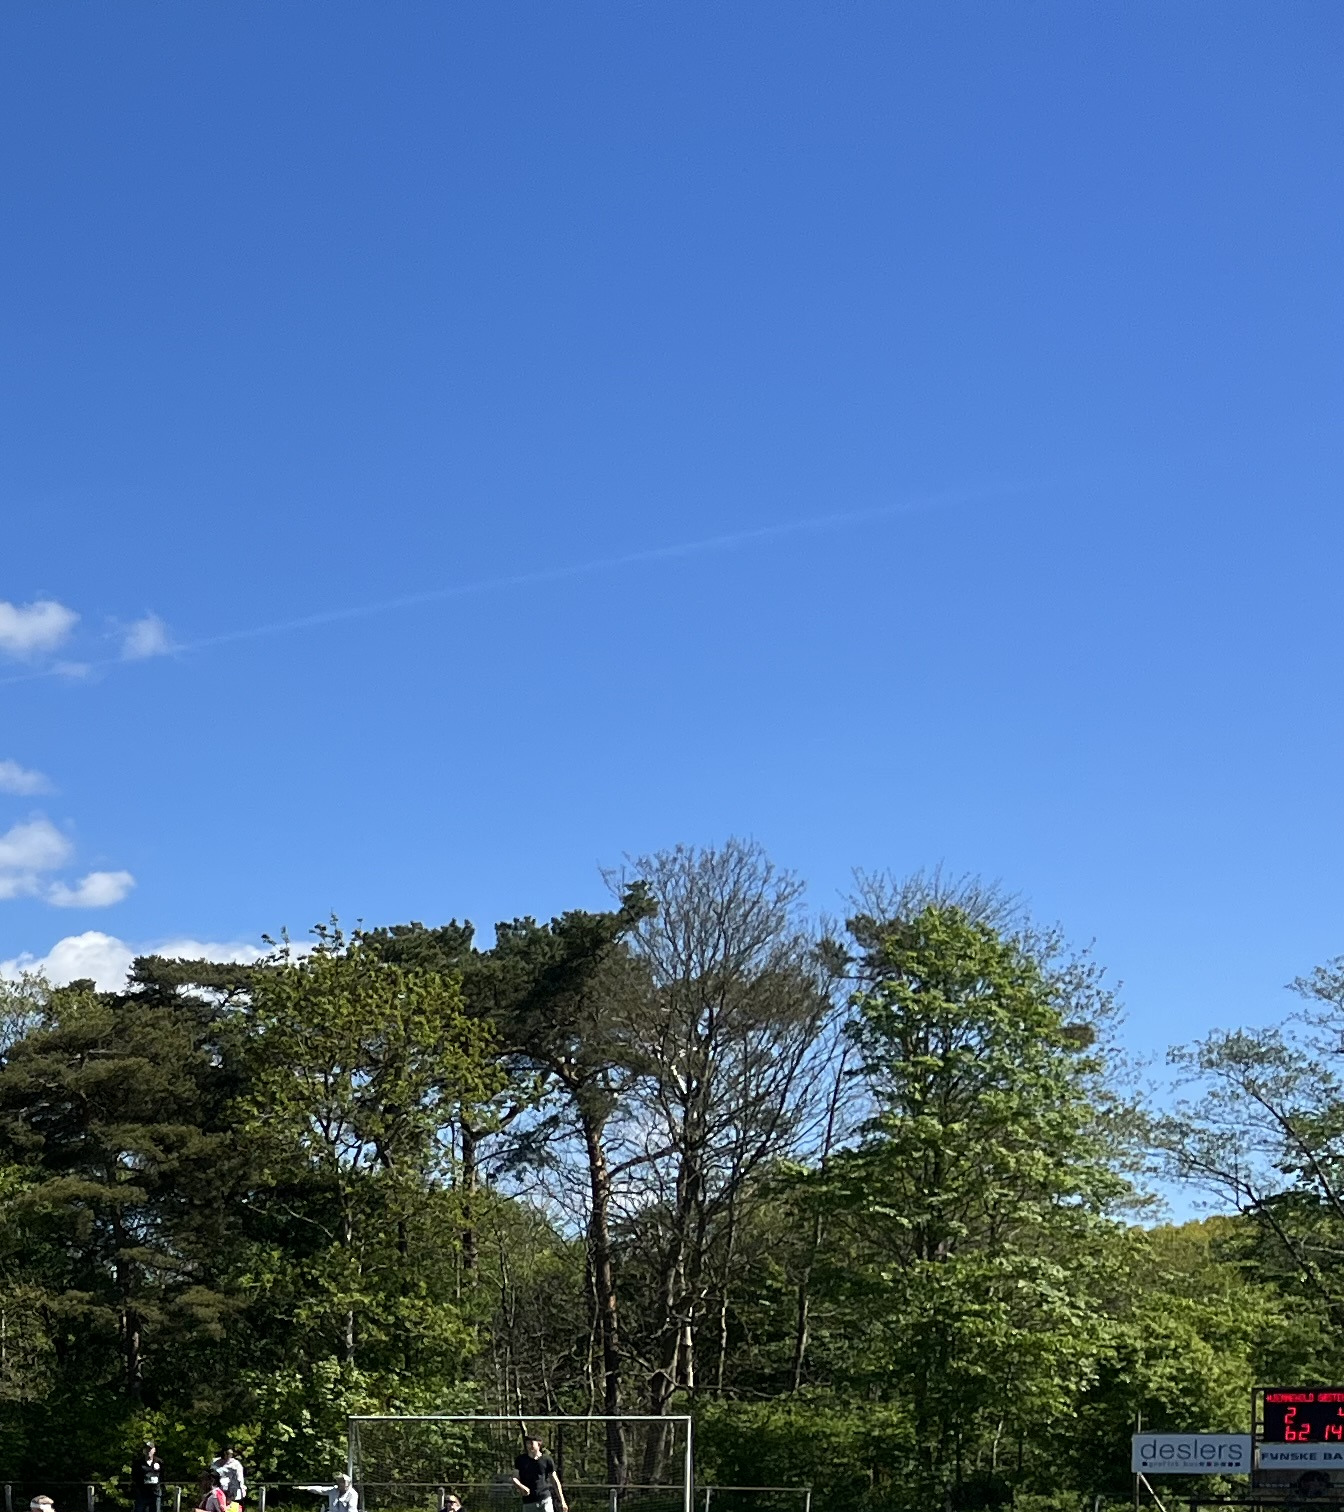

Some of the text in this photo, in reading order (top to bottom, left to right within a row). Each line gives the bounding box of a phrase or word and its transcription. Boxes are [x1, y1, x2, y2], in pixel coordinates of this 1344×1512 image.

[1140, 1437, 1243, 1460] deslers
[1261, 1452, 1344, 1461] FYNSKE BA
